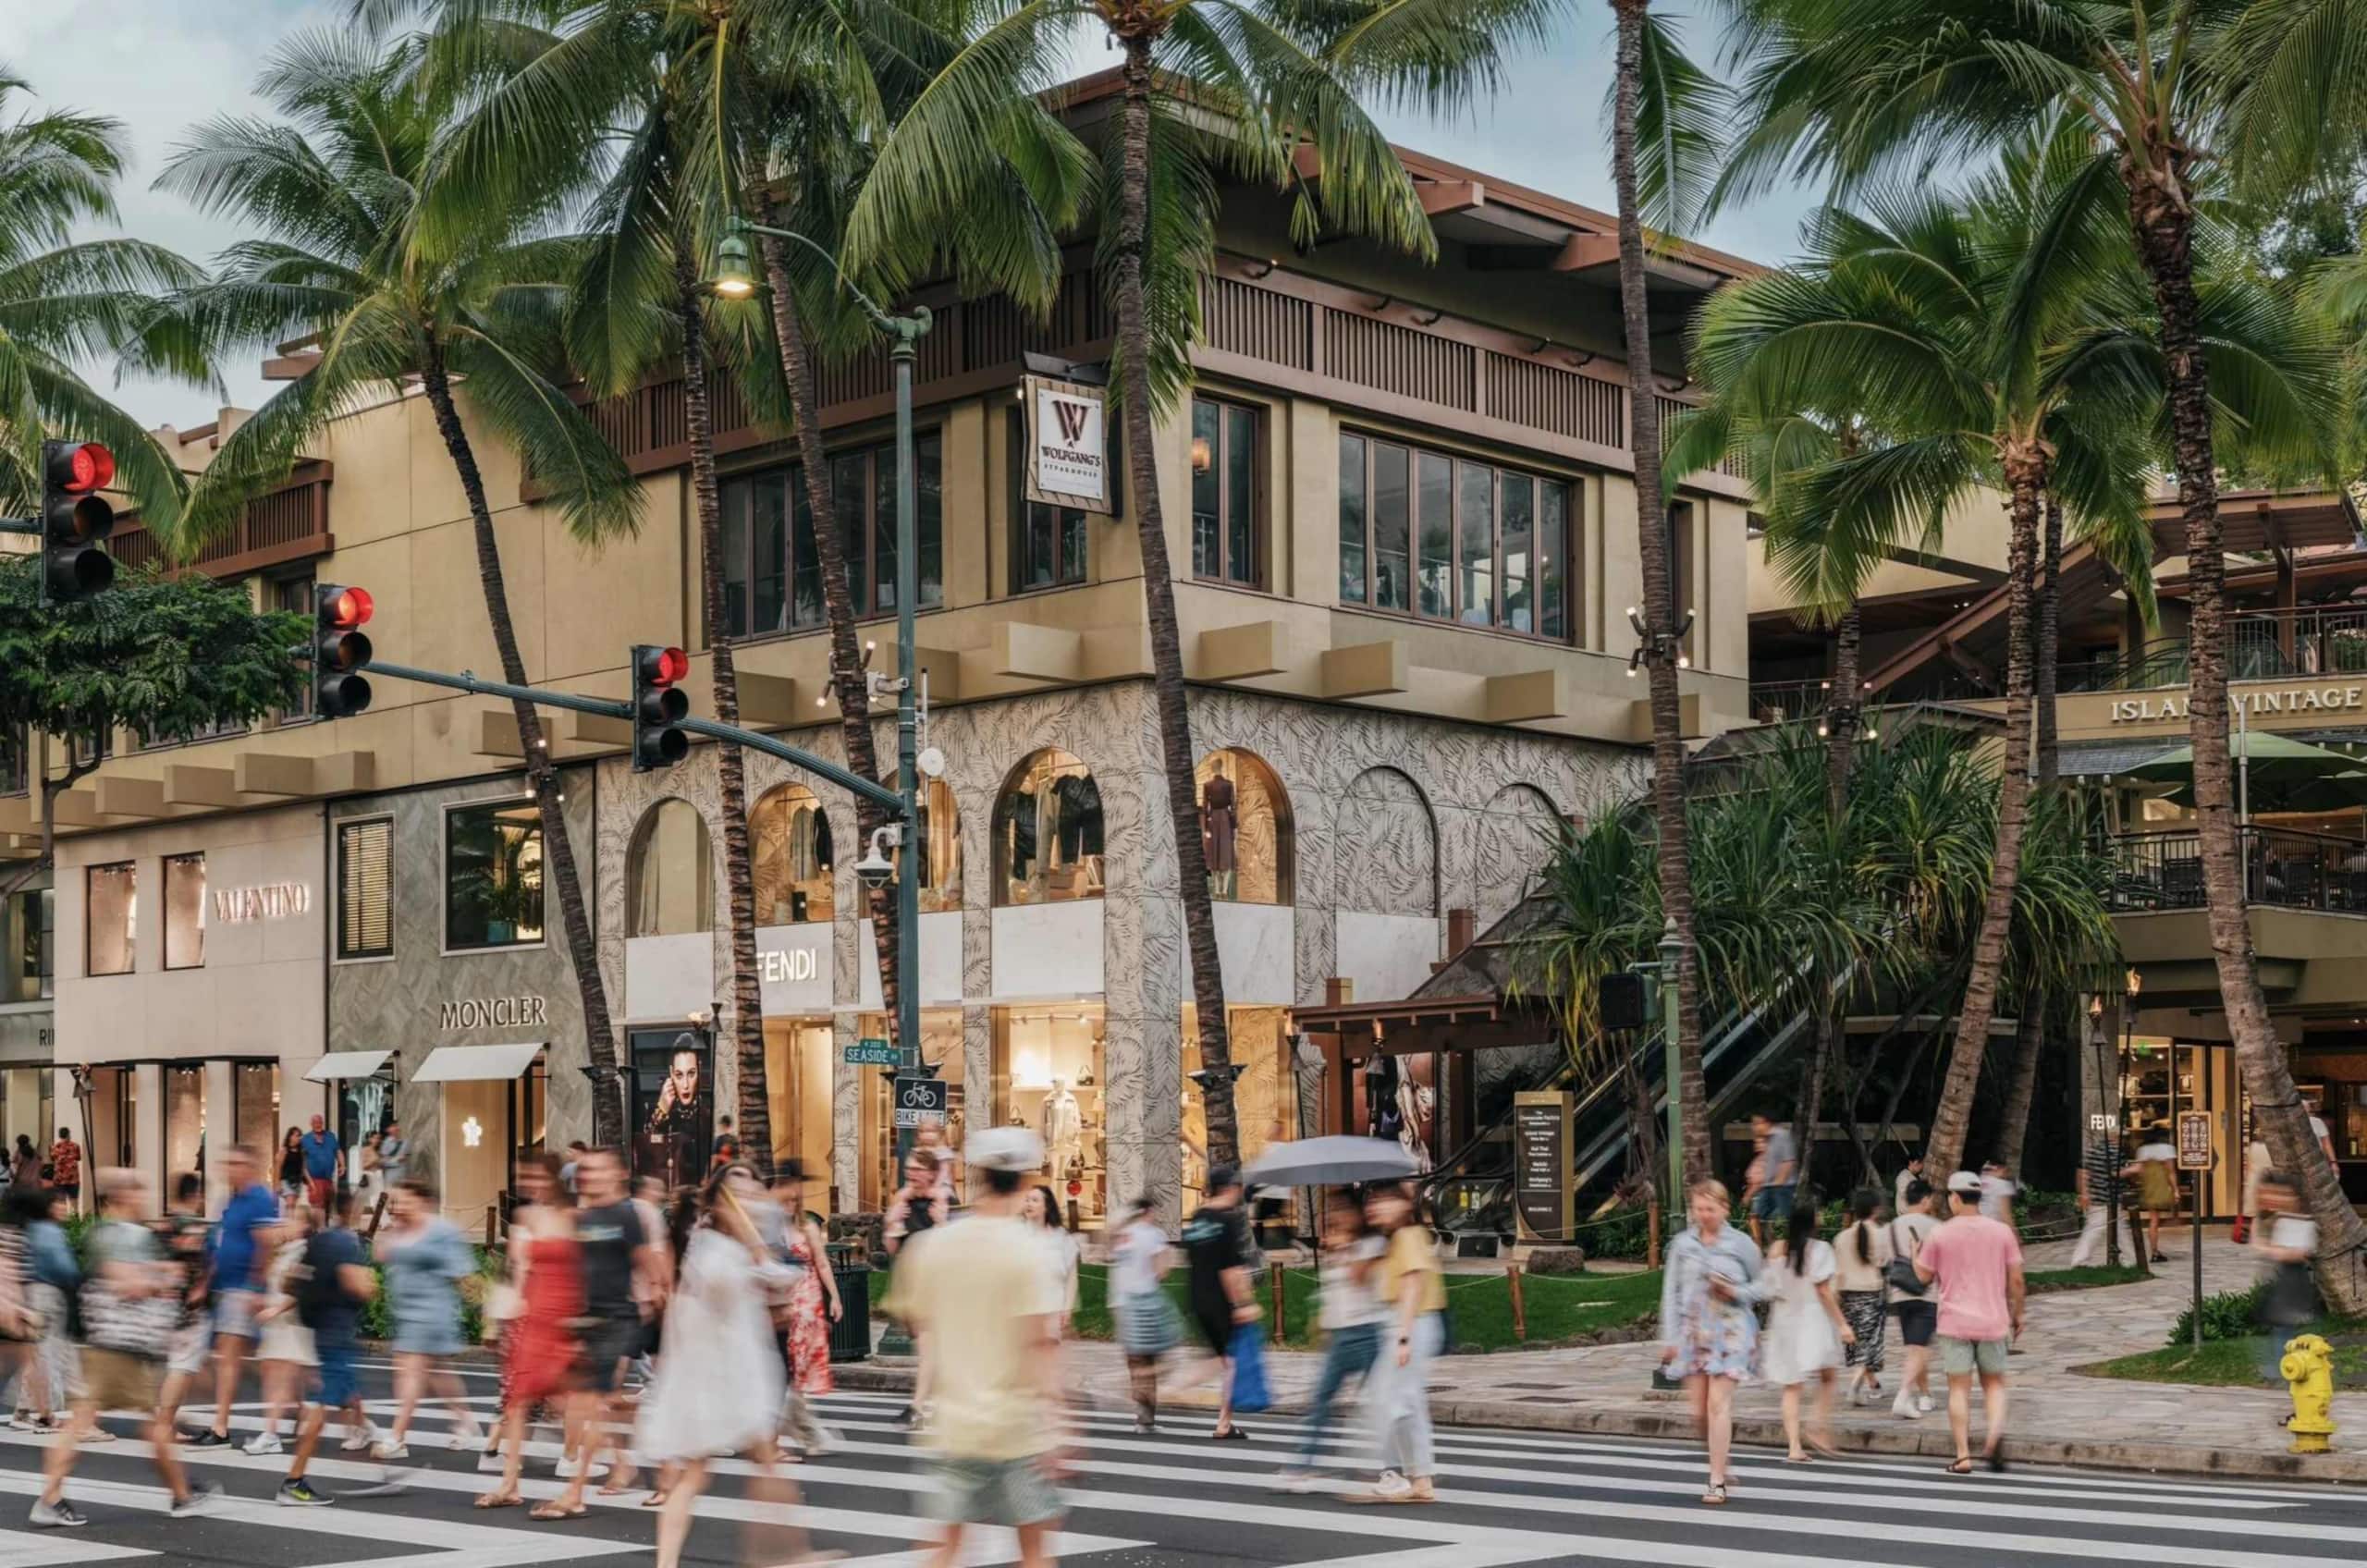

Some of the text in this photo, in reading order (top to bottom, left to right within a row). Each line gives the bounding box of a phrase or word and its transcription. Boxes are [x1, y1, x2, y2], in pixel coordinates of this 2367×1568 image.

[1052, 399, 1091, 442] W
[1041, 446, 1101, 467] WOLFGANG'S
[2111, 687, 2362, 721] ISLA VINTAGE
[213, 883, 308, 923] VALENTINO
[440, 997, 547, 1029] MONCLER
[846, 1048, 889, 1063] SEASIDE
[896, 1110, 916, 1124] BIKE
